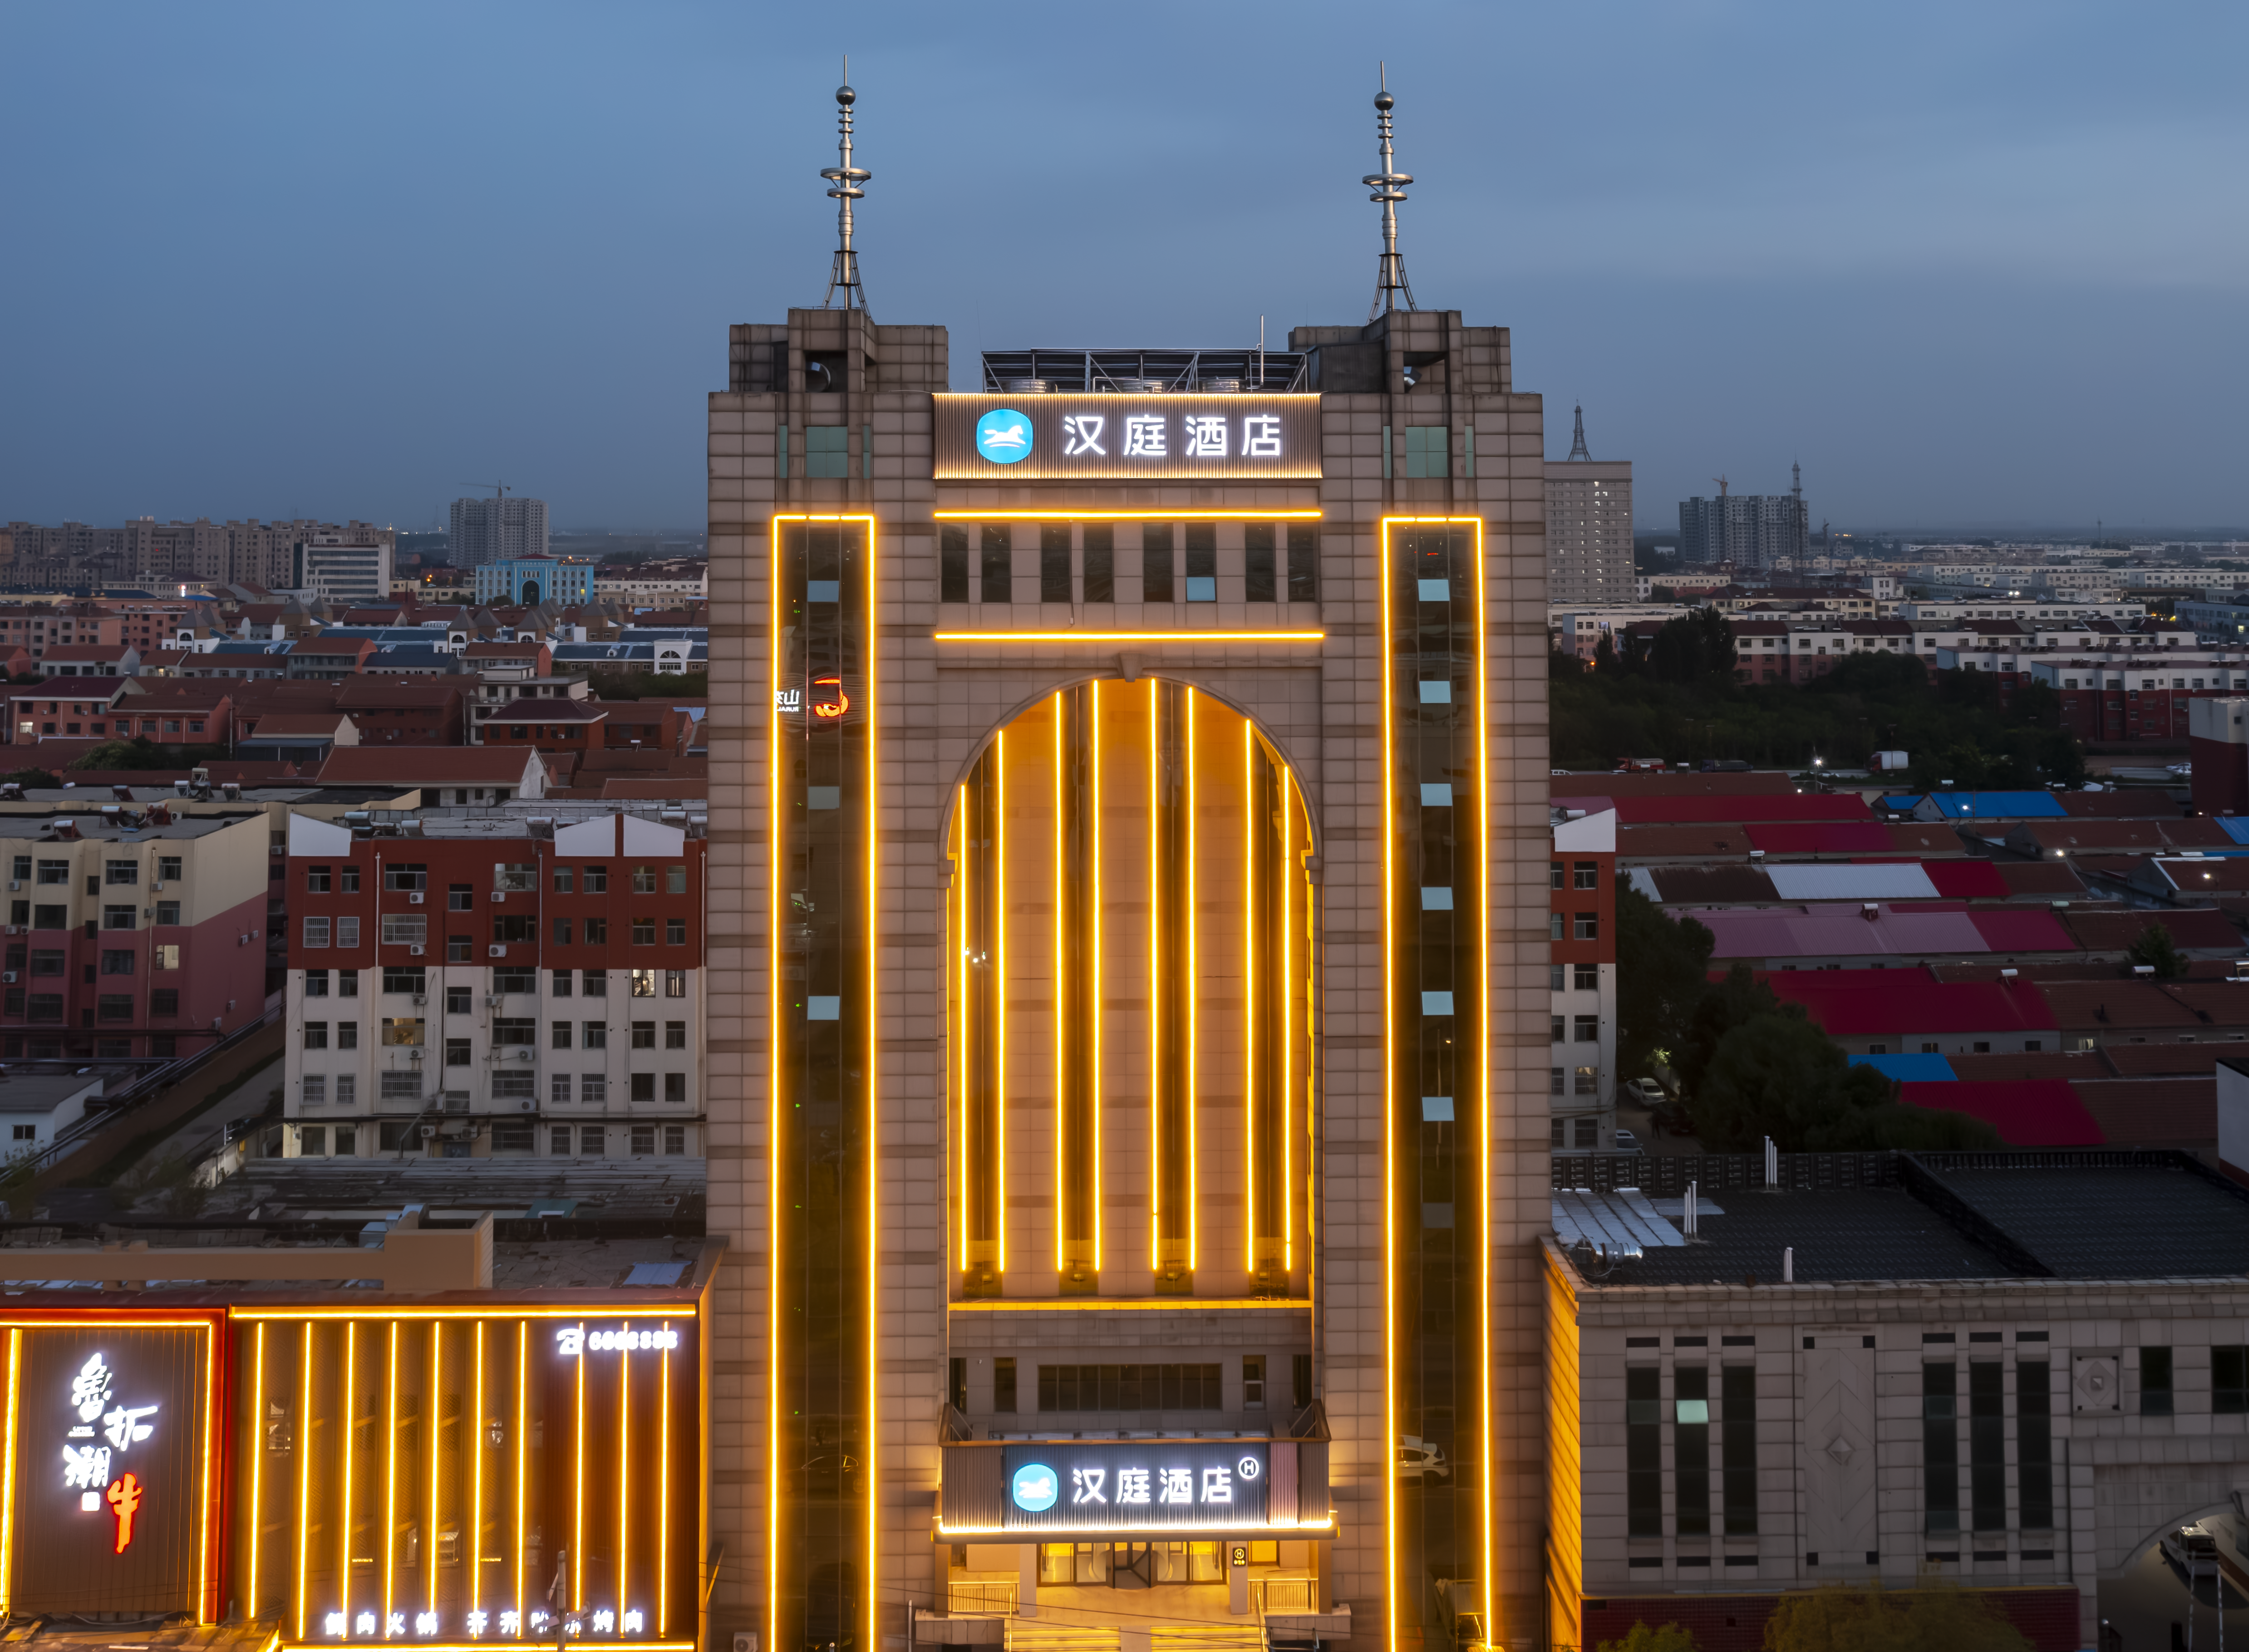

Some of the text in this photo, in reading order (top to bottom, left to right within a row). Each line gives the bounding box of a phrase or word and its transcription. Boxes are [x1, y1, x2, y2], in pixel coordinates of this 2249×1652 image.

[1064, 414, 1280, 456] 汉庭酒店
[1073, 1466, 1232, 1504] 汉庭酒店
